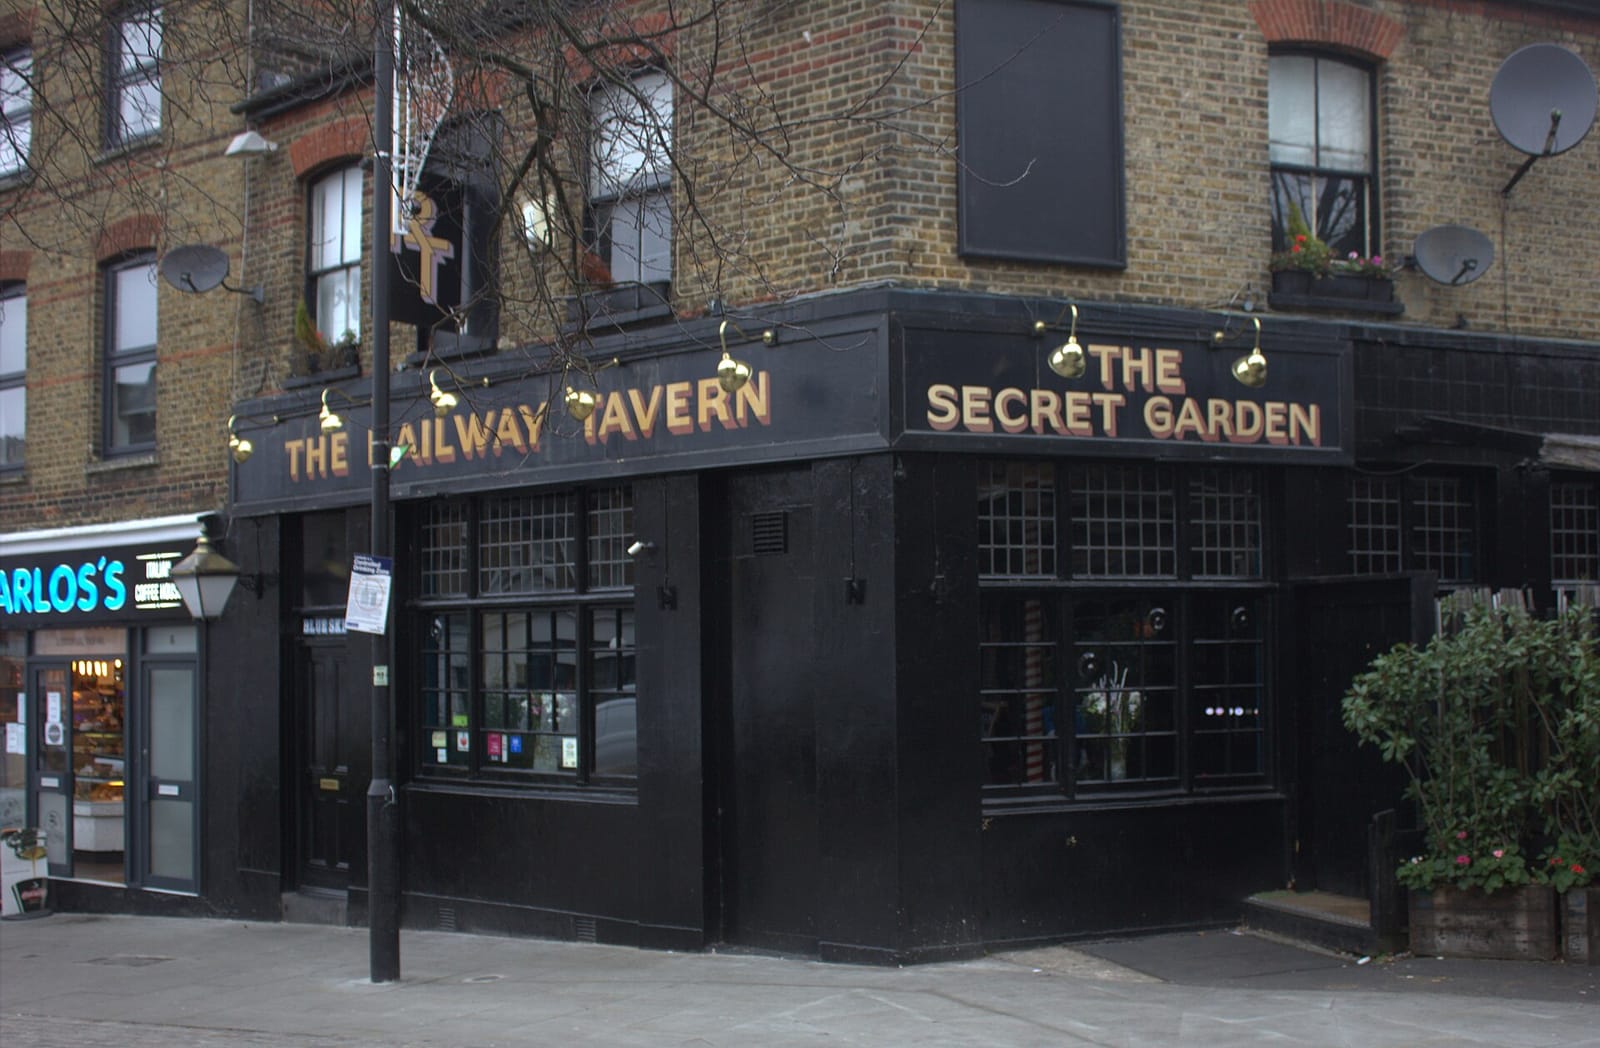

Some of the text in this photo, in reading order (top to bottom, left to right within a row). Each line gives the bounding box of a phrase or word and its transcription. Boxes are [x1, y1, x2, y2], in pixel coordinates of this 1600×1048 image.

[1088, 344, 1186, 394] THE
[284, 431, 348, 482] THE
[367, 401, 547, 469] AILWAY
[927, 383, 1321, 447] SECRET GARDEN
